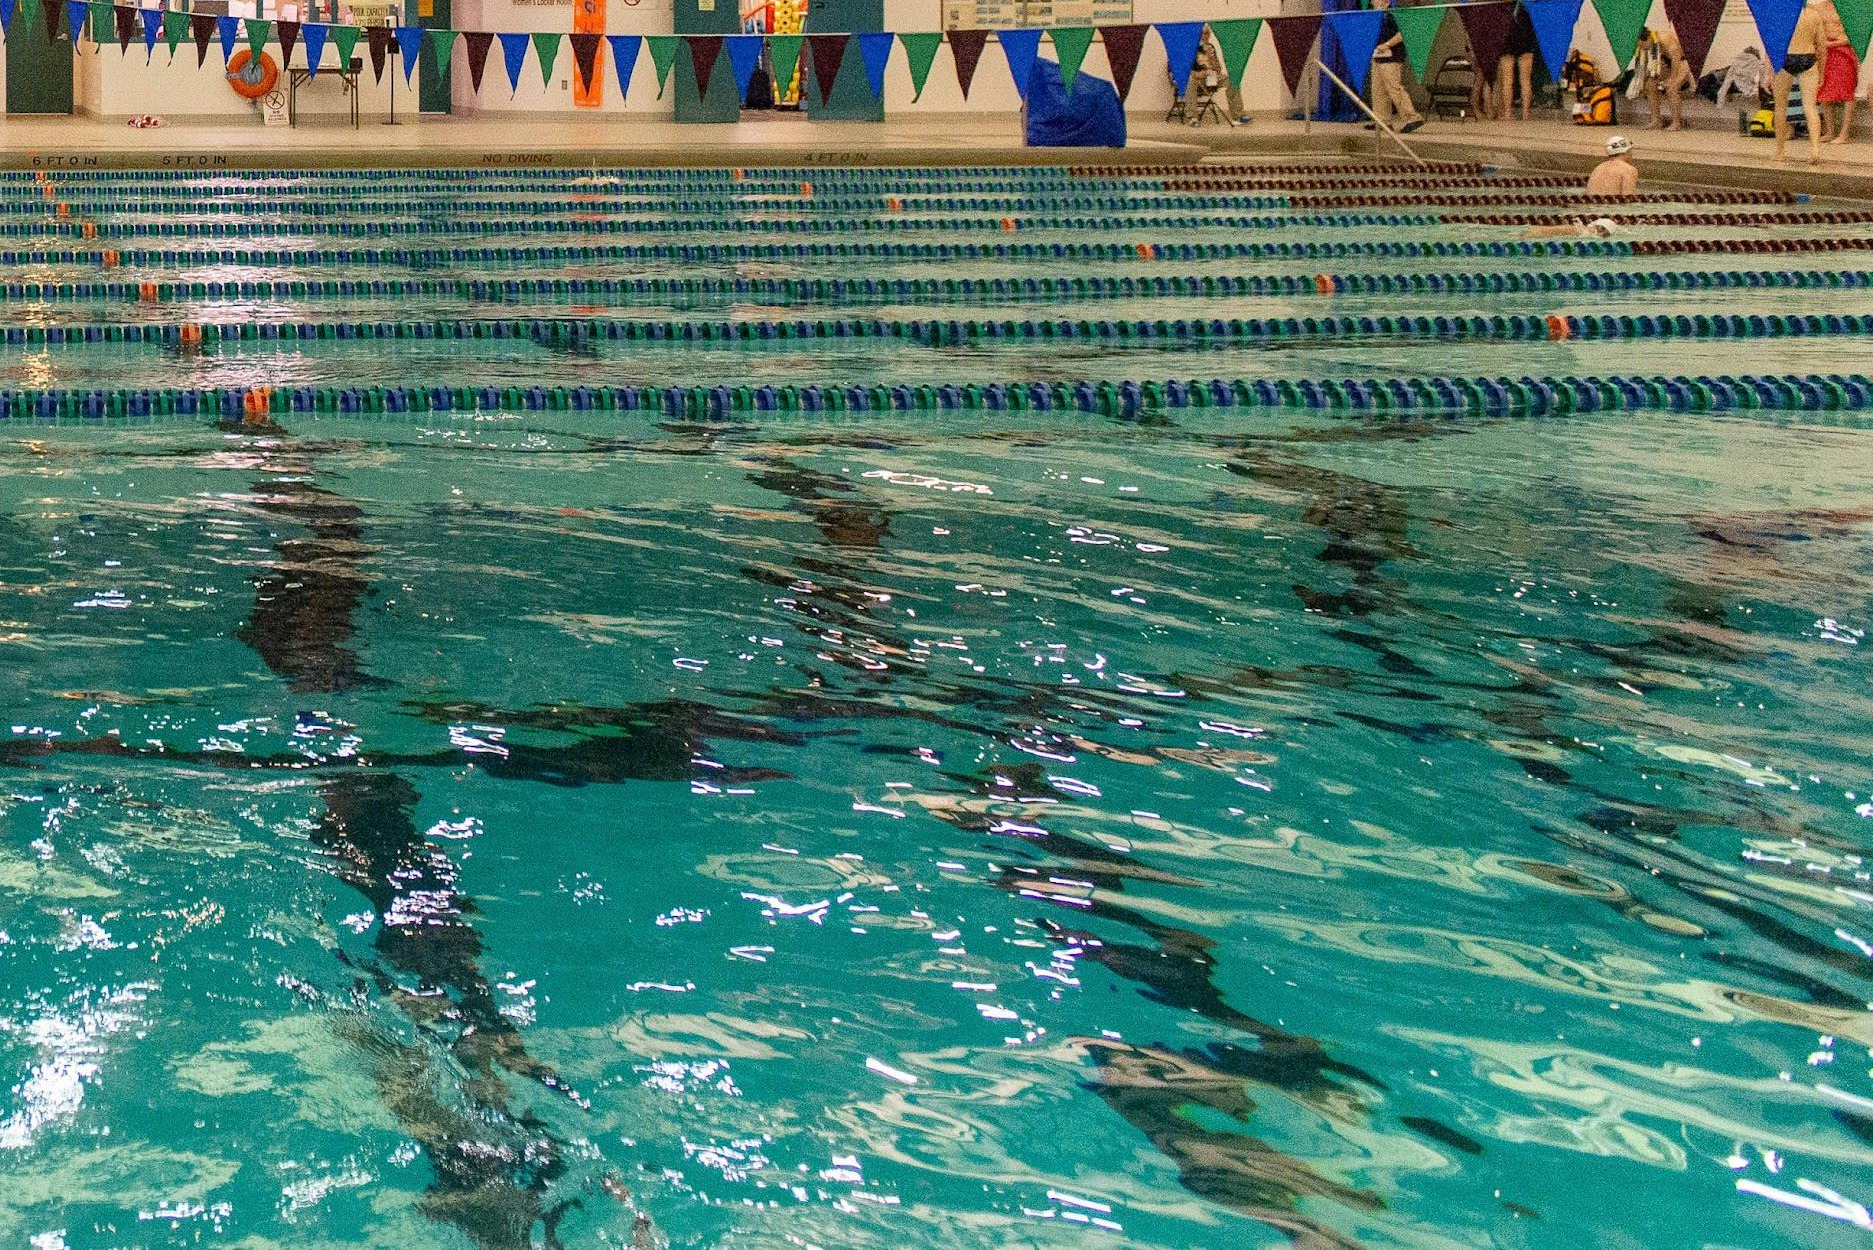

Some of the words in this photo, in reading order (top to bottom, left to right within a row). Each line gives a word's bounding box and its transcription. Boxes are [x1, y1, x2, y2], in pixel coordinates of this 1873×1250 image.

[32, 156, 41, 166] 6
[47, 156, 64, 166] FT
[84, 156, 98, 166] IN
[162, 155, 171, 165] 5
[177, 155, 194, 165] FT
[213, 155, 227, 165] IN
[481, 153, 503, 164] NO
[508, 153, 553, 164] DIVING
[804, 153, 813, 162] 4
[818, 153, 836, 162] FT
[854, 152, 869, 162] IN
